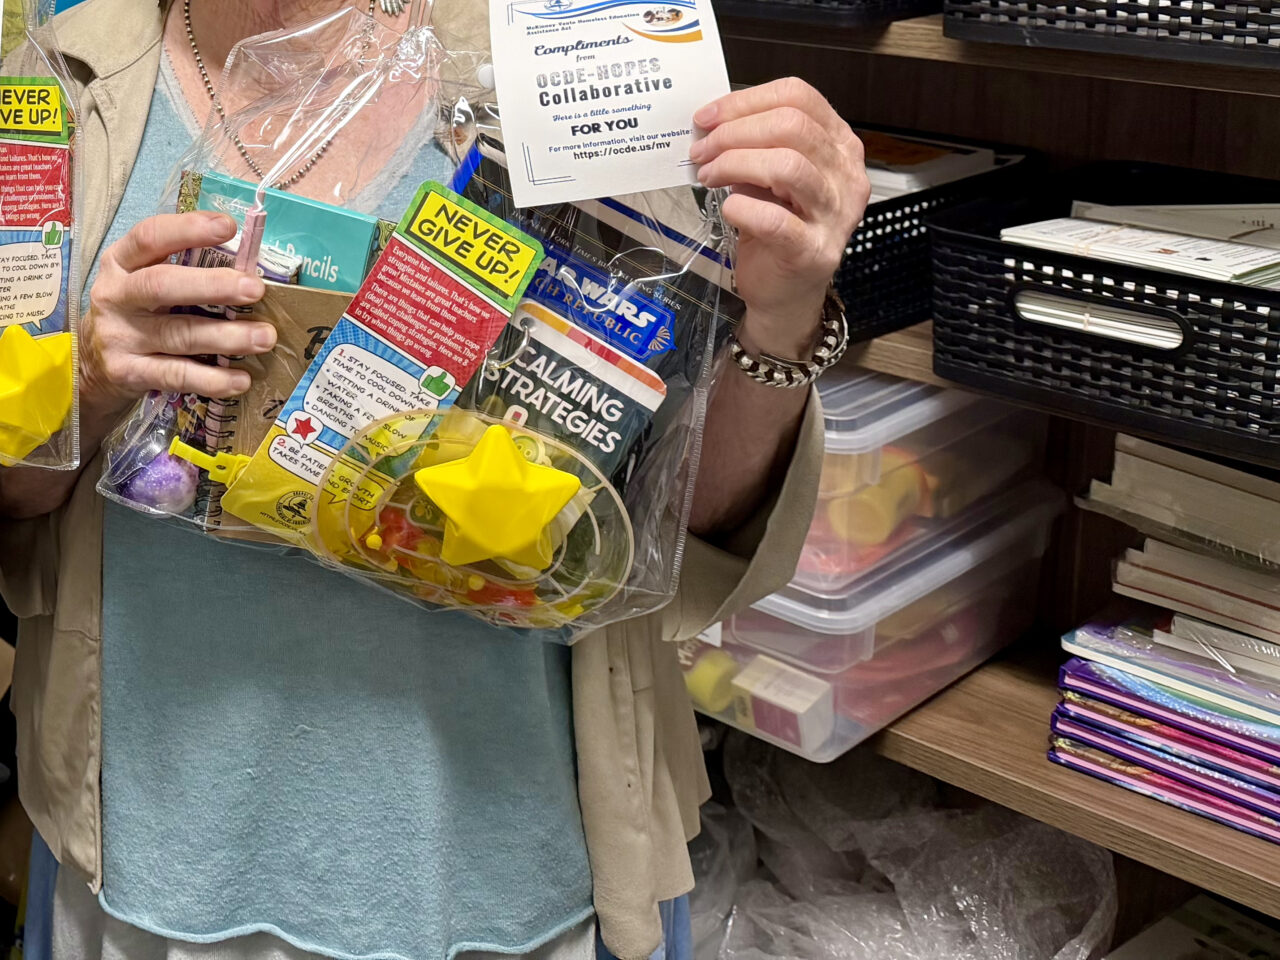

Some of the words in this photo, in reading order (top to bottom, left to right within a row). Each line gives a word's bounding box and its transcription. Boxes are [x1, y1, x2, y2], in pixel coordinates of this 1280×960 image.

[533, 33, 634, 59] Compliments
[575, 52, 596, 62] from
[535, 56, 661, 89] OCDE-HOPES
[538, 74, 673, 106] Collaborative
[29, 108, 58, 125] UP!
[551, 112, 573, 122] Here
[573, 111, 582, 119] is
[589, 107, 610, 117] little
[610, 102, 652, 115] something
[570, 122, 601, 136] FOR
[604, 117, 639, 131] YOU
[562, 143, 581, 151] more
[582, 137, 626, 149] information,
[628, 134, 645, 142] visit
[660, 128, 692, 138] website:
[573, 139, 671, 161] https://ocde.us/mv
[433, 200, 522, 264] NEVER
[391, 245, 420, 267] Everyone
[417, 261, 431, 273] has
[414, 215, 474, 261] GIVE
[473, 248, 520, 286] UP!
[376, 271, 402, 291] because
[400, 286, 411, 296] we
[409, 291, 427, 305] learn
[424, 300, 442, 314] from
[439, 308, 459, 324] them.
[385, 254, 416, 277] struggles
[413, 270, 427, 282] and
[424, 276, 452, 297] failures.
[449, 291, 470, 308] That's
[467, 302, 482, 314] how
[397, 273, 425, 293] Mistakes
[423, 289, 435, 299] are
[433, 295, 452, 310] great
[450, 303, 478, 324] teachers
[537, 253, 584, 290] AR
[575, 276, 658, 332] WARS
[652, 289, 683, 311] SERIES
[369, 282, 389, 298] There
[386, 293, 398, 303] are
[395, 298, 418, 316] things
[415, 310, 430, 322] that
[429, 318, 441, 328] can
[439, 324, 454, 337] help
[452, 332, 465, 344] you
[463, 339, 480, 352] cope
[560, 292, 643, 346] REPUBLIC
[325, 378, 358, 401] WATER
[346, 354, 370, 372] STAY
[370, 368, 409, 395] FOCUSED.
[409, 390, 431, 407] TAKE
[512, 342, 628, 426] CALMING
[310, 403, 348, 429] DANCING
[481, 357, 623, 456] STRATEGIES
[381, 422, 407, 441] SLOW
[270, 445, 299, 466] TAKES
[298, 461, 321, 479] TIME
